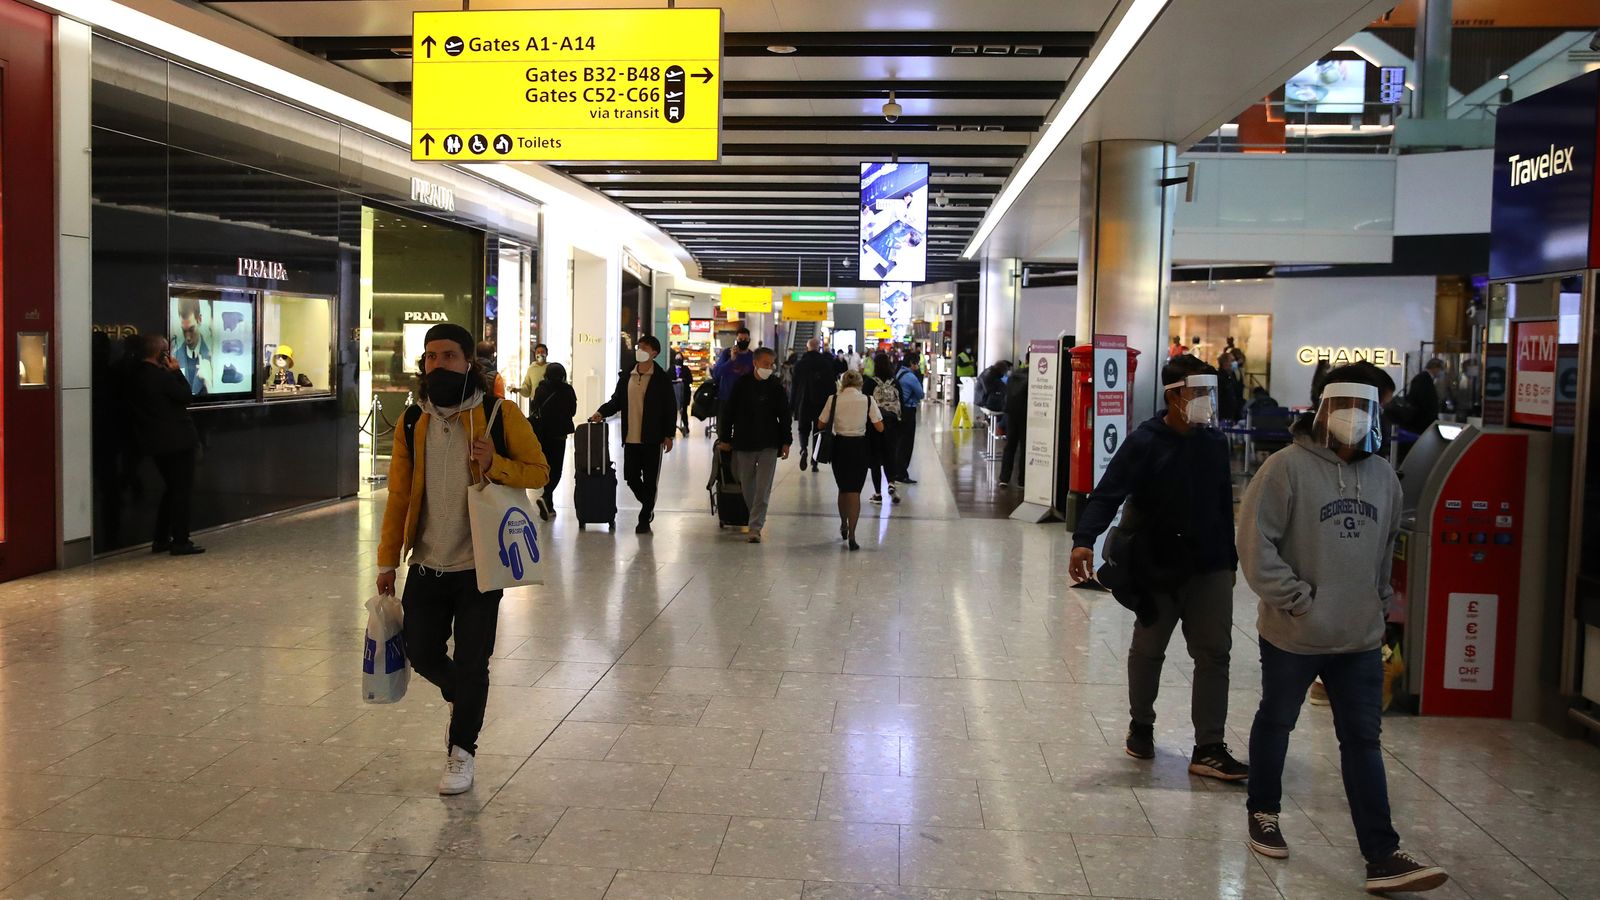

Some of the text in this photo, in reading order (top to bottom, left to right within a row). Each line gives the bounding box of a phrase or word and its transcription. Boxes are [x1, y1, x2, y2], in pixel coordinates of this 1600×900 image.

[469, 35, 596, 52] Gates A1-A14
[525, 66, 661, 83] Gates B32-B48
[525, 87, 660, 103] Gates C52-C66
[590, 107, 660, 119] via transit
[517, 136, 562, 149] Toilets
[1508, 143, 1574, 187] Travelex
[411, 176, 455, 212] PRADA
[238, 257, 289, 281] PRADA
[404, 311, 449, 322] PRADA
[1519, 335, 1554, 361] ATM
[1298, 347, 1402, 366] CHANEL
[1320, 498, 1378, 524] GEORGETOWN
[1343, 516, 1356, 530] G
[1467, 601, 1479, 613] £
[1466, 622, 1478, 634] €
[1464, 644, 1476, 657] $
[1458, 666, 1480, 675] CHF
